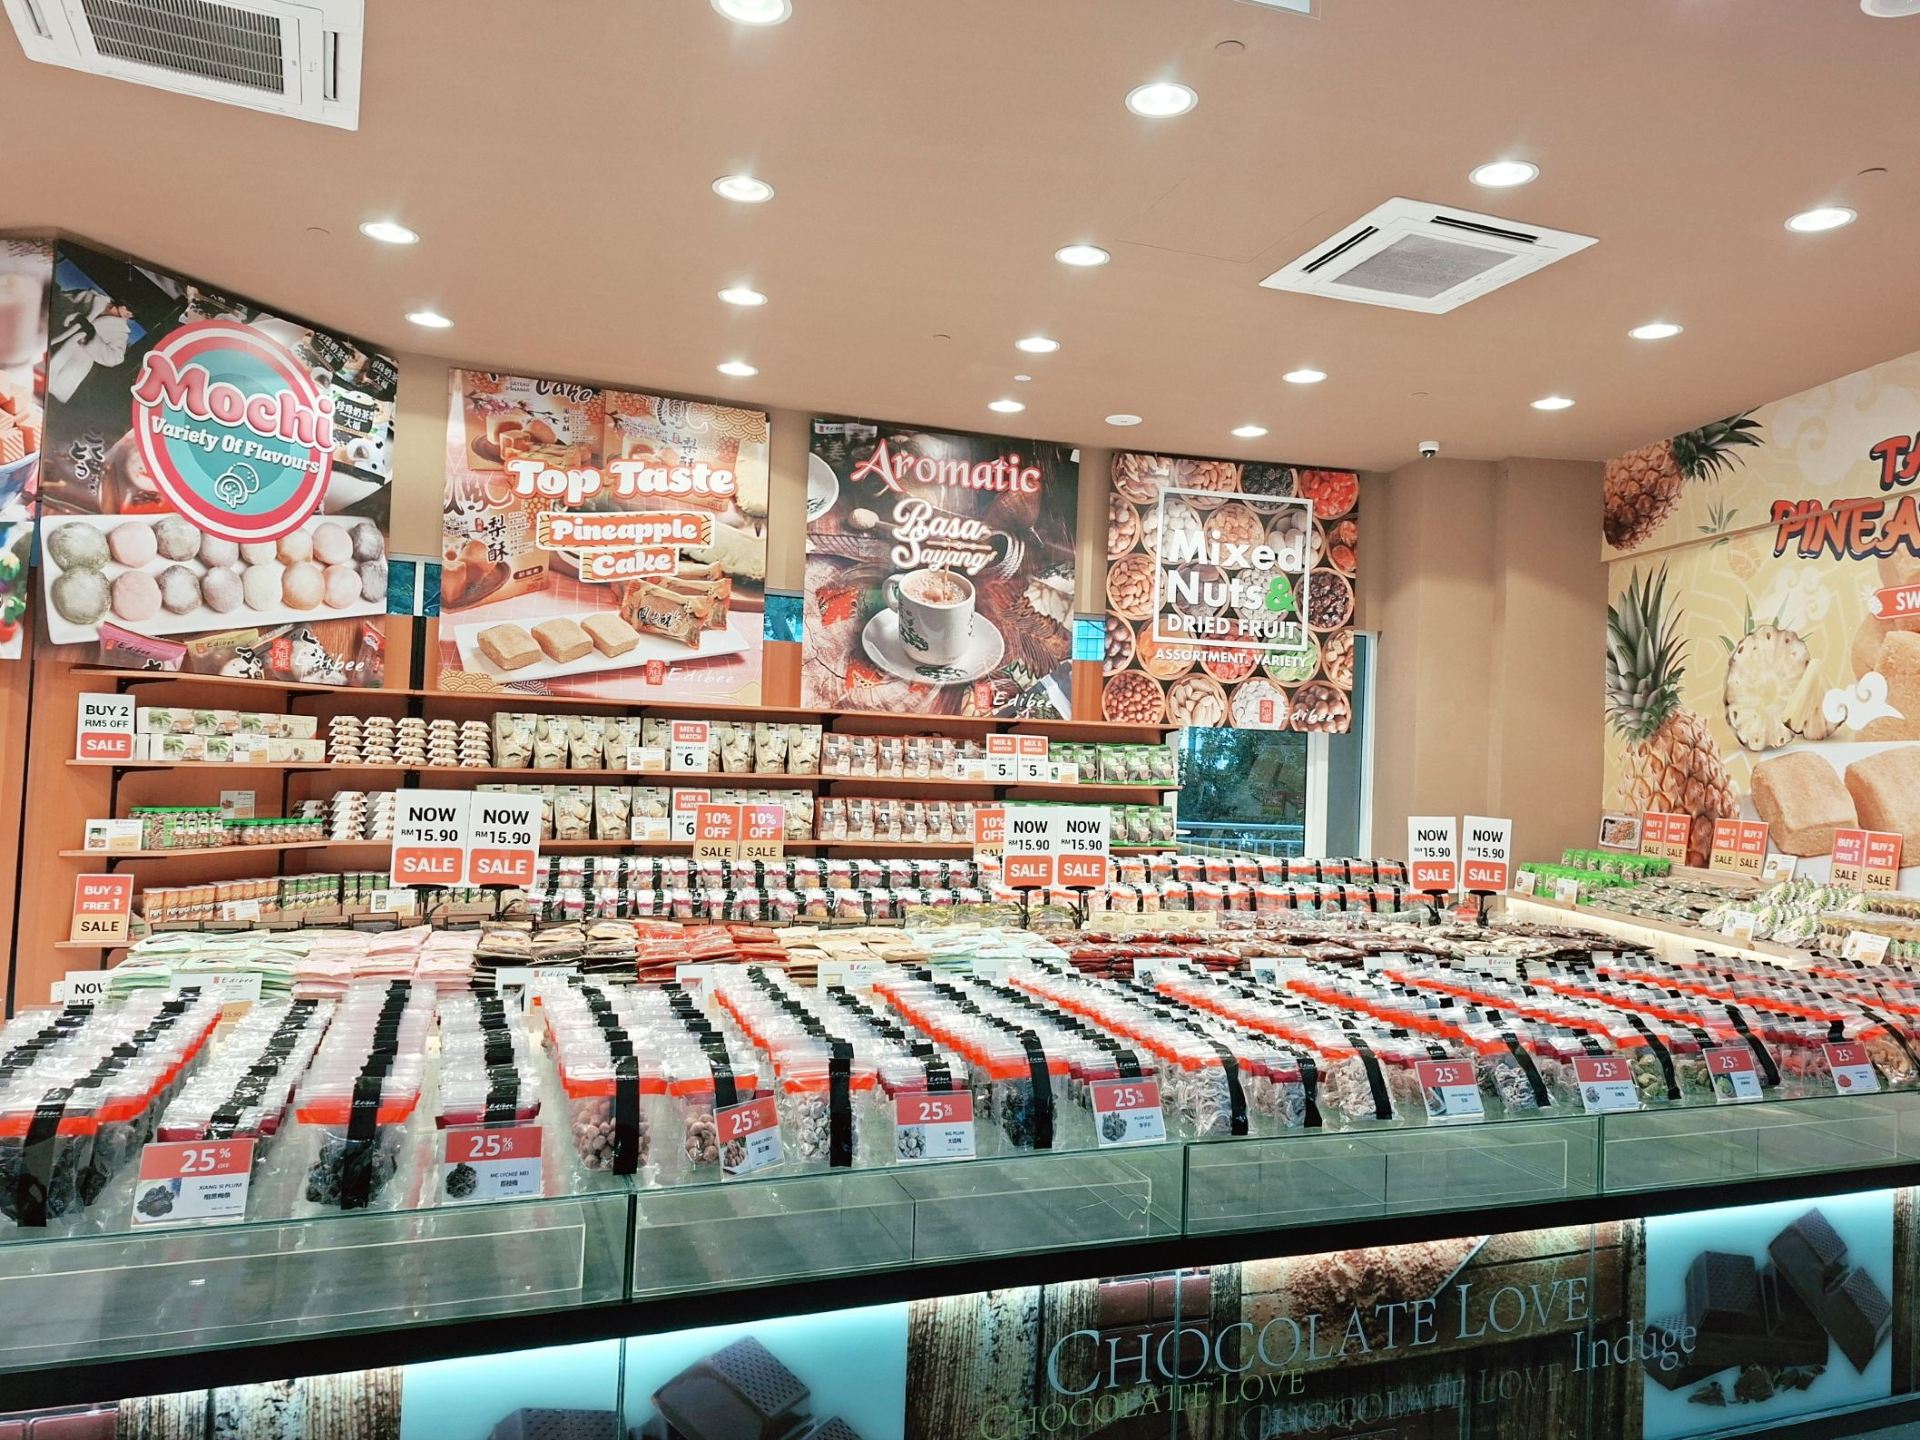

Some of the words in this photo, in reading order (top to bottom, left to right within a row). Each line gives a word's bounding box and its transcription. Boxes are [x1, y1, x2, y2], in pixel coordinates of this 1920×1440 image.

[535, 379, 593, 403] Cake
[131, 352, 335, 453] Mochi
[344, 418, 361, 430] 大福
[150, 415, 218, 453] Variety
[221, 435, 243, 454] Of
[243, 440, 320, 474] Flavours
[851, 438, 1041, 493] Aromatic
[506, 458, 600, 506] Top
[609, 457, 736, 496] Taste
[892, 497, 991, 541] Basa
[488, 514, 508, 561] 梨酥
[550, 518, 698, 544] Pineapple
[891, 527, 997, 576] Sayang
[1169, 529, 1305, 573] Mixed
[592, 550, 673, 577] Cake
[1167, 569, 1264, 610] Nuts
[1264, 576, 1297, 613] &
[1167, 614, 1231, 635] DRIED
[1238, 621, 1298, 640] FRUIT
[1253, 654, 1307, 668] VARIETY
[669, 667, 734, 684] Edibee
[993, 691, 1053, 708] Edibee
[85, 704, 117, 716] BUY
[120, 706, 129, 717] 2
[85, 719, 107, 728] RM5
[110, 720, 129, 728] OFF
[86, 739, 126, 751] SALE
[684, 753, 694, 766] 6
[998, 764, 1006, 776] 5
[1029, 765, 1037, 777] 5
[409, 807, 457, 822] NOW
[483, 809, 530, 825] NOW
[704, 812, 732, 825] 10%
[750, 813, 776, 825] 10%
[686, 822, 695, 836] 6
[704, 827, 731, 838] OFF
[749, 827, 775, 838] OFF
[1013, 820, 1048, 834] NOW
[1066, 820, 1101, 834] NOW
[1717, 827, 1730, 835] BUY
[401, 829, 414, 837] RM
[415, 829, 458, 842] 15.90
[489, 831, 531, 845] 15.90
[982, 831, 1004, 841] OFF
[1417, 829, 1449, 842] NOW
[1472, 829, 1504, 843] NOW
[1744, 830, 1757, 838] BUY
[1019, 839, 1050, 850] 15.90
[1071, 839, 1103, 851] 15.90
[1643, 844, 1659, 854] SALE
[1730, 839, 1734, 848] 1
[1756, 842, 1760, 850] 1
[1838, 838, 1853, 847] BUY
[1854, 840, 1860, 848] 2
[1871, 842, 1887, 851] BUY
[1888, 843, 1894, 853] 2
[700, 846, 731, 857] SALE
[747, 847, 777, 857] SALE
[1423, 847, 1451, 858] 15.90
[1476, 847, 1505, 859] 15.90
[1667, 848, 1683, 857] SALE
[1836, 852, 1852, 861] FREE
[1853, 851, 1859, 862] 1
[403, 857, 455, 873] SALE
[1714, 854, 1733, 864] SALE
[1739, 858, 1758, 869] SALE
[1869, 857, 1886, 867] FREE
[1887, 856, 1893, 867] 1
[477, 859, 527, 875] SALE
[1010, 864, 1047, 877] SALE
[1063, 863, 1101, 877] SALE
[1417, 869, 1450, 882] SALE
[1468, 868, 1503, 883] SALE
[1834, 869, 1857, 880] SALE
[1867, 874, 1891, 886] SALE
[84, 885, 110, 896] BUY
[113, 885, 122, 895] 3
[82, 901, 111, 911] FREE
[112, 898, 120, 910] 1
[80, 920, 119, 932] SALE
[1435, 1067, 1458, 1082] 25%
[1593, 1062, 1616, 1078] 25%
[1113, 1088, 1144, 1108] 25%
[919, 1102, 953, 1120] 25%
[731, 1110, 760, 1135] 25%
[469, 1134, 513, 1157] 25%
[180, 1148, 231, 1173] 25%
[1048, 1298, 1438, 1396] CHOCOLATE
[1455, 1276, 1590, 1340] LOVE
[1571, 1320, 1698, 1373] Induge
[979, 1381, 1209, 1440] CHOCOLATE
[1221, 1367, 1306, 1405] LOVE
